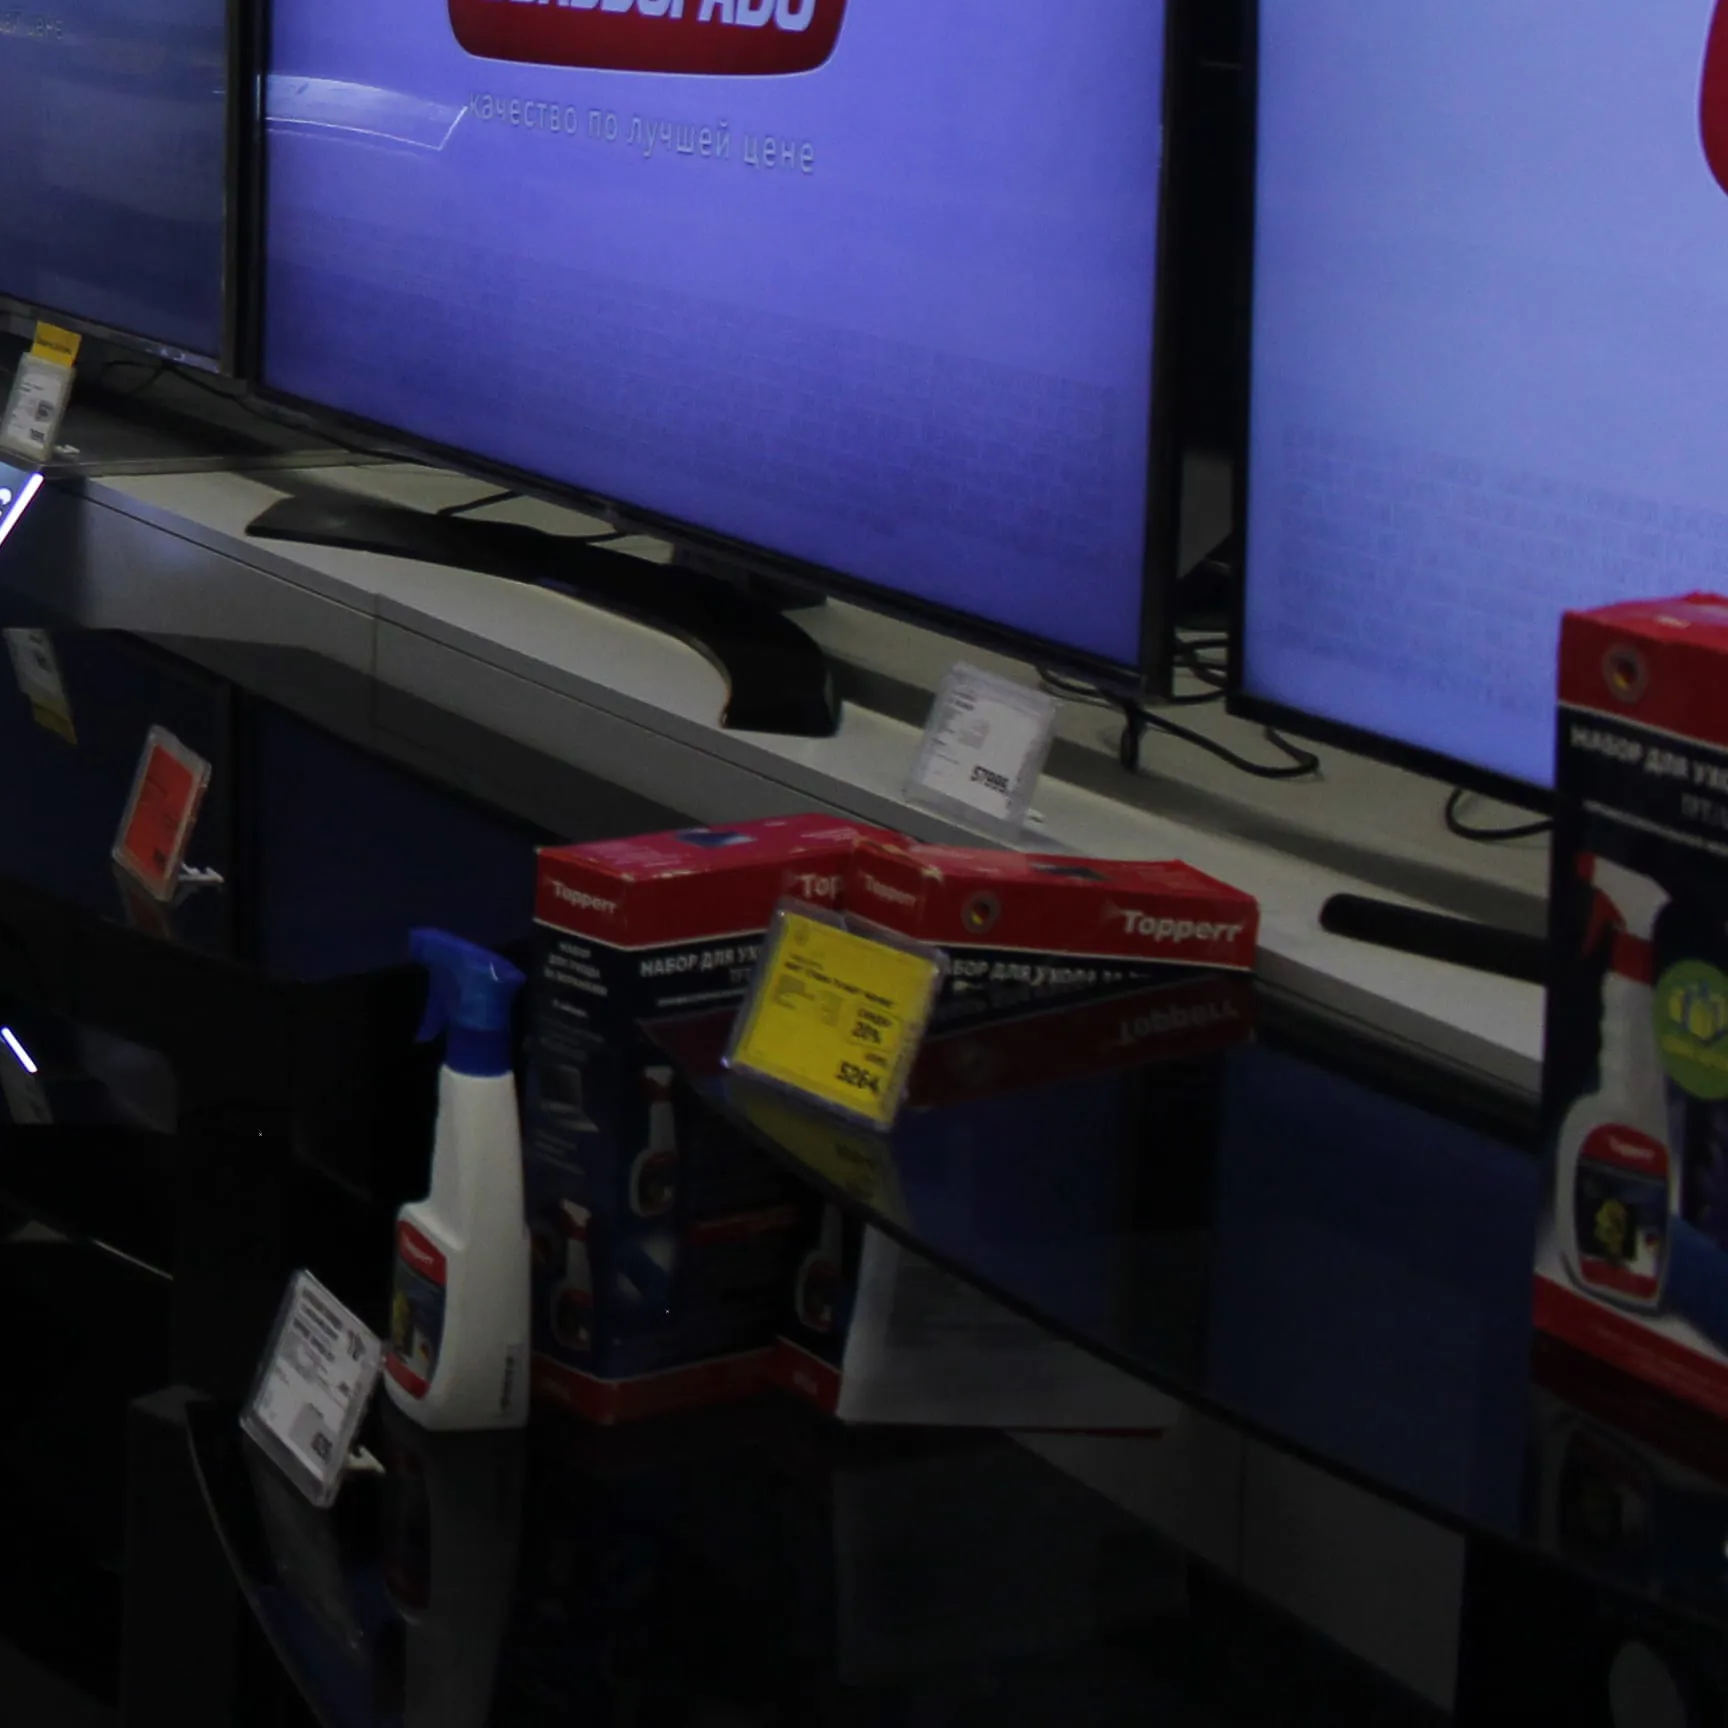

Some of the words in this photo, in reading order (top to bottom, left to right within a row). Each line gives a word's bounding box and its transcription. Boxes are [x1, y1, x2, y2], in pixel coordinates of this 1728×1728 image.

[469, 91, 579, 135] качество
[588, 108, 619, 141] по
[626, 117, 731, 159] лучшей
[743, 133, 816, 175] цене
[551, 878, 618, 915] Topperr
[1121, 908, 1244, 945] Topperr
[638, 953, 698, 978] НАБОР
[699, 949, 735, 972] ДЛЯ
[737, 944, 763, 965] УХ
